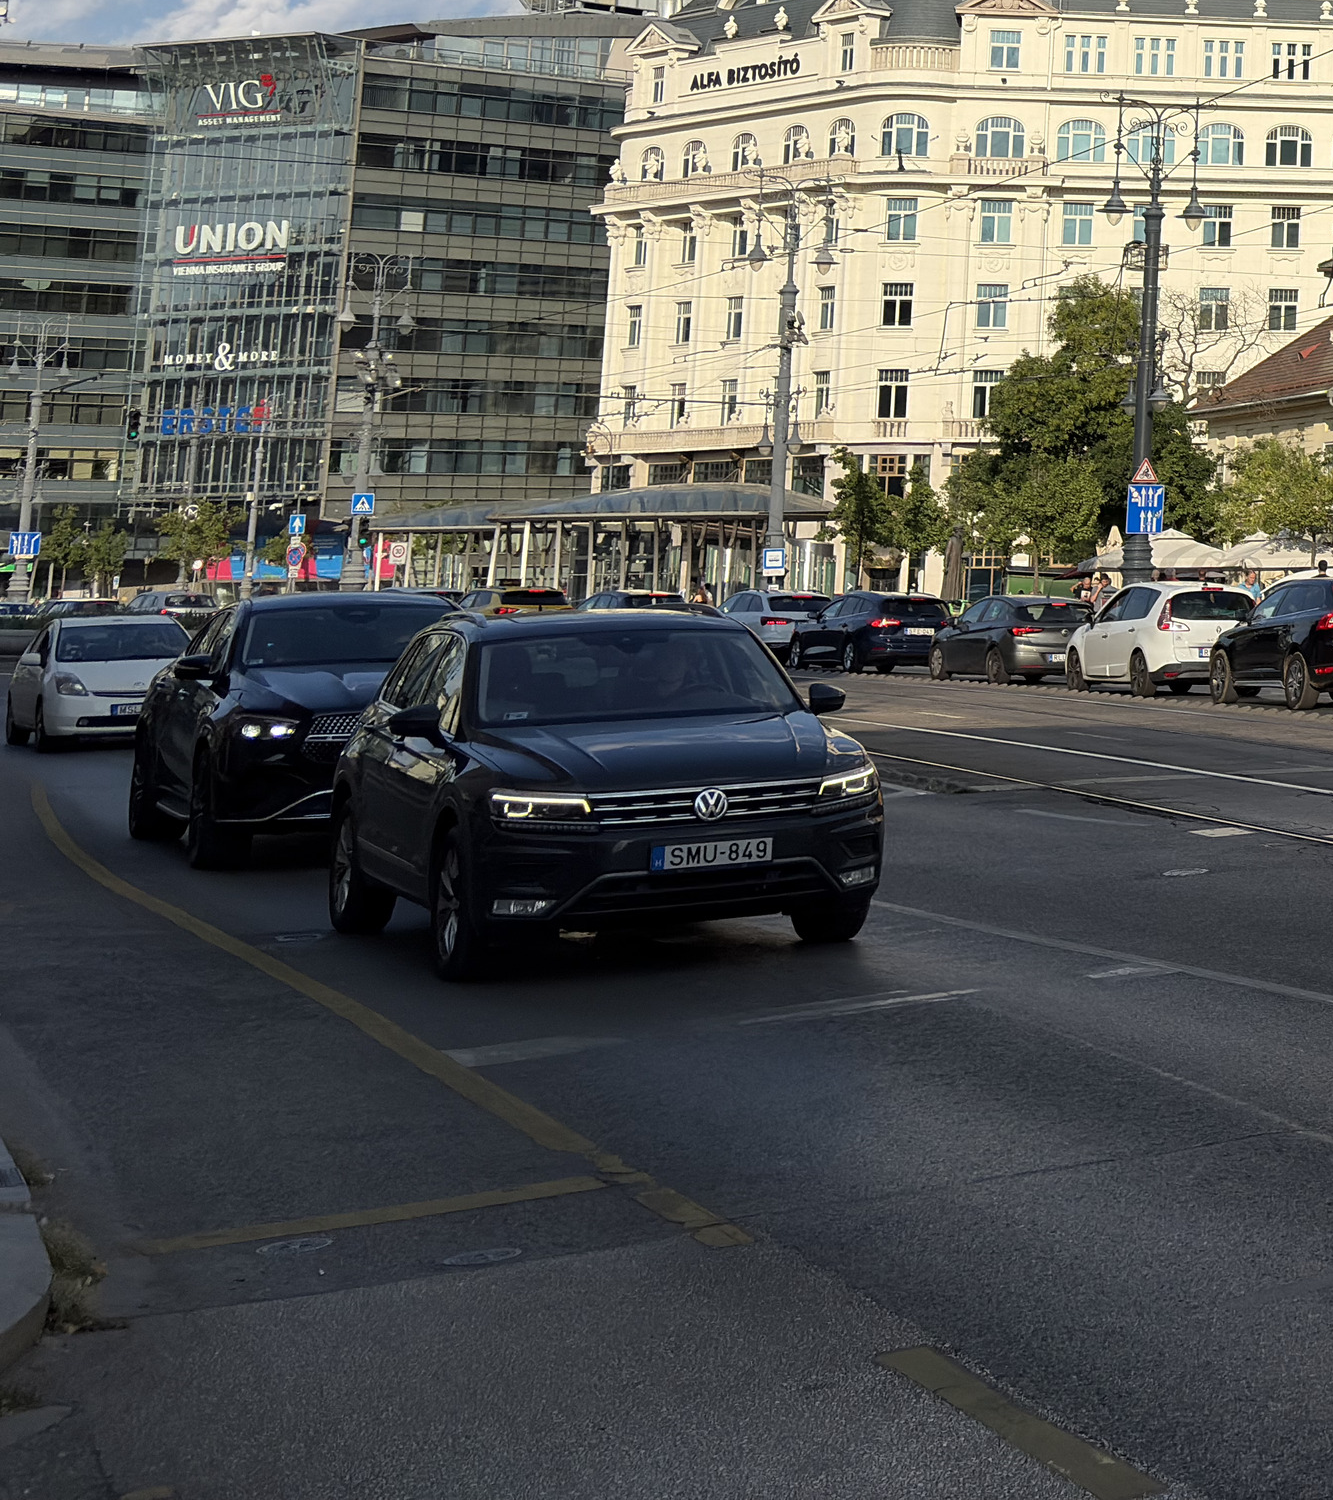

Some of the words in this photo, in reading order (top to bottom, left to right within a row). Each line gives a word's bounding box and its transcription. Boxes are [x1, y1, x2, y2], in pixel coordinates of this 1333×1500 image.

[690, 71, 722, 92] ALFA
[727, 52, 800, 86] BIZTOSÍTÓ
[203, 80, 263, 111] VIG
[198, 117, 223, 126] ASSET
[226, 114, 281, 124] MANAGEMENT
[175, 220, 289, 254] UNION
[173, 266, 205, 276] VIENNA
[205, 263, 253, 274] INSURANCE
[255, 262, 286, 272] GROUP
[163, 353, 213, 365] MONEY
[214, 342, 236, 371] &
[237, 350, 278, 362] MORE
[161, 405, 252, 435] ERSTE
[669, 840, 767, 866] SMU-849
